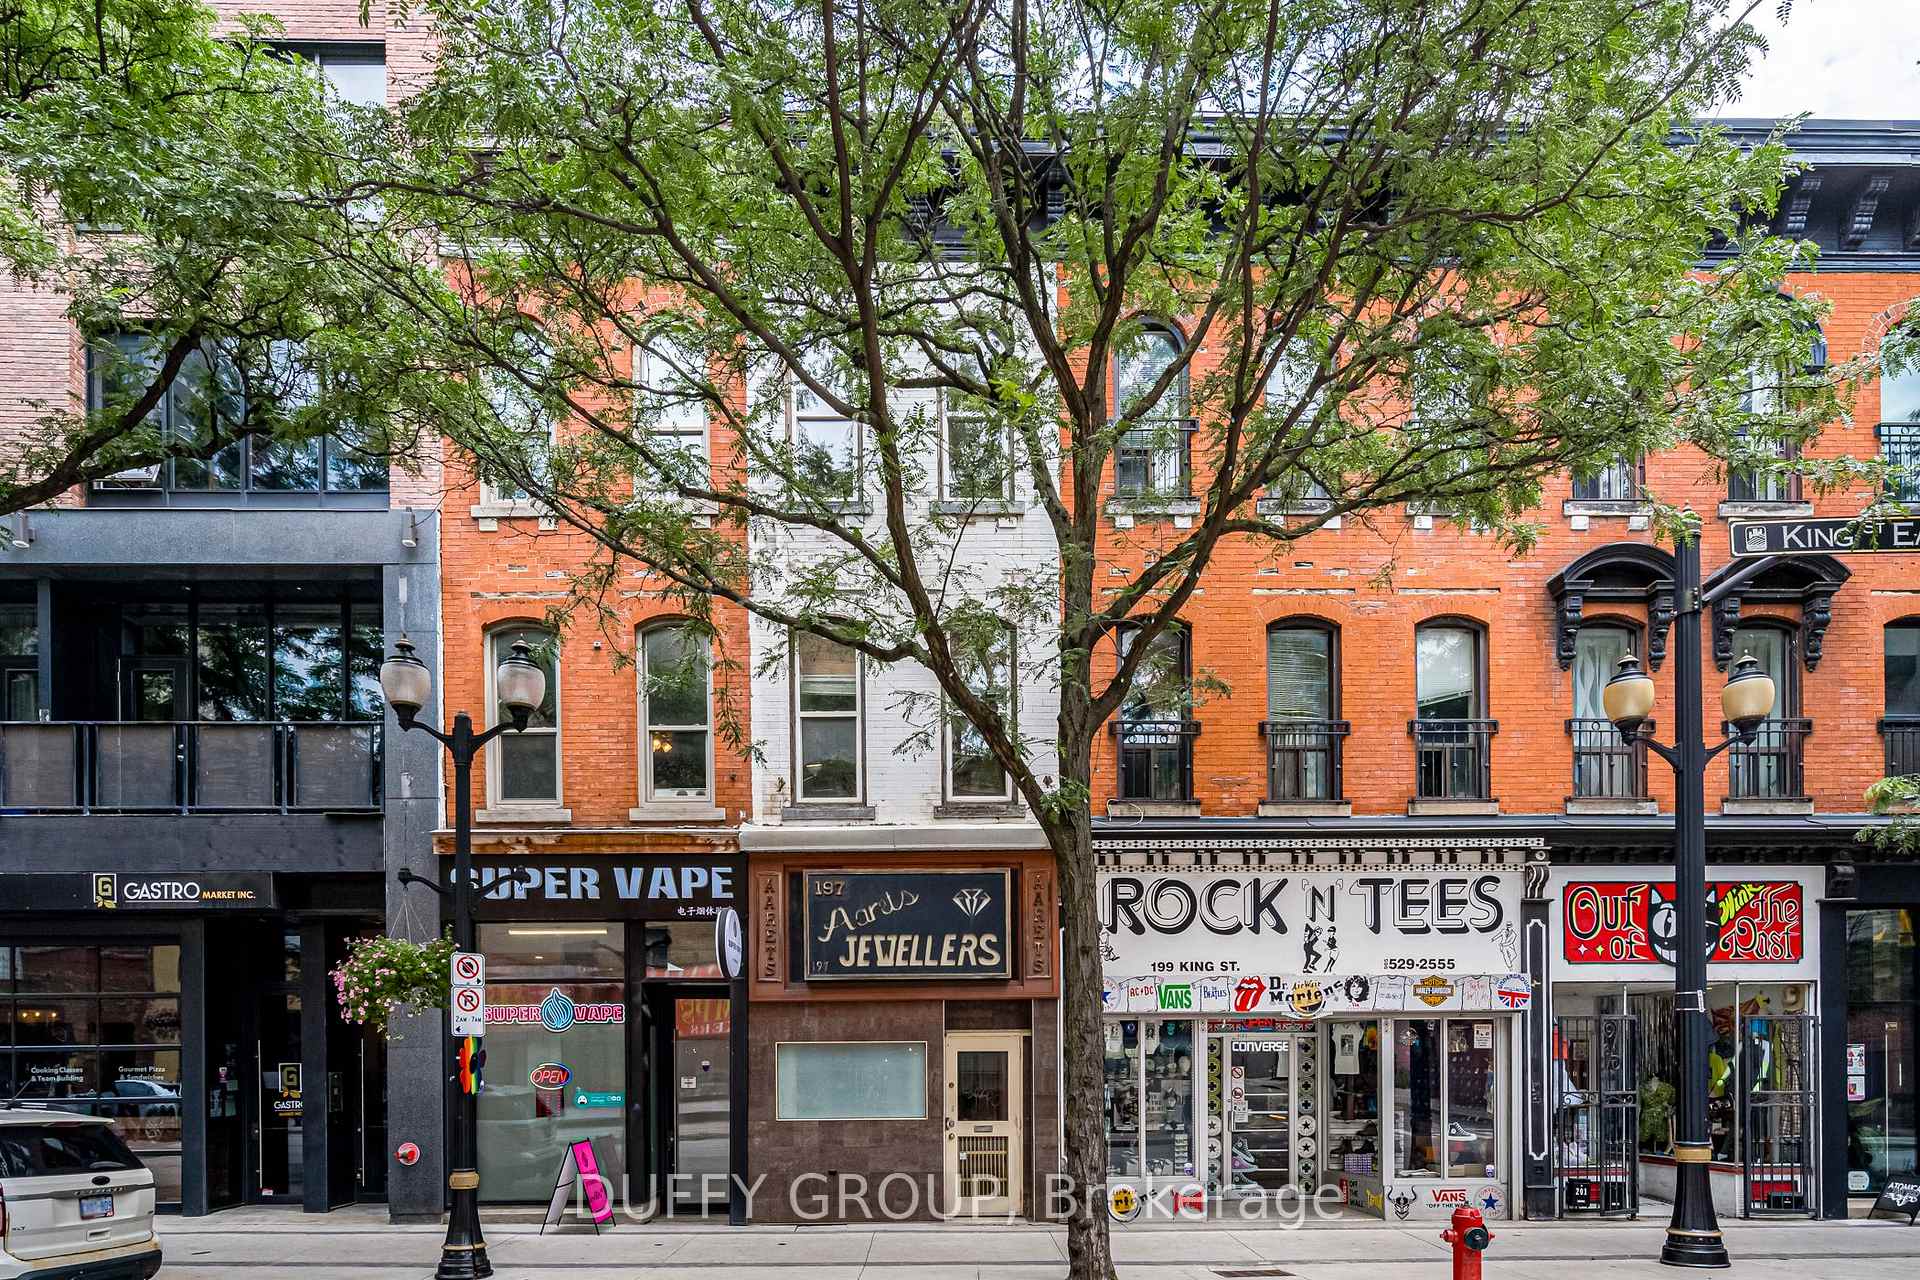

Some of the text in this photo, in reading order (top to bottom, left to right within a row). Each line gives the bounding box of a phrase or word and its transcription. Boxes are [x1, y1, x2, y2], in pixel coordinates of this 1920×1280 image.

[1782, 524, 1855, 549] KING
[1863, 521, 1886, 535] ST
[123, 881, 257, 900] GASTRO MARKET INC.
[612, 866, 735, 899] VAPE
[814, 880, 845, 896] 197
[1102, 877, 1290, 936] ROCK
[1349, 875, 1504, 935] TEES
[1567, 883, 1649, 941] Out
[1608, 929, 1649, 961] of
[1719, 915, 1800, 961] Past
[838, 934, 1001, 967] JEWELLERS
[1151, 961, 1241, 972] 199 KING ST.
[1388, 958, 1456, 970] 529-2555
[1269, 976, 1289, 990] Dr.
[1157, 984, 1193, 1010] VANS
[1268, 980, 1344, 1003] Martens
[484, 1005, 624, 1021] SUPER VAPE
[1232, 1041, 1289, 1052] CONVERSE
[30, 1065, 83, 1075] Cooking Classes
[118, 1065, 147, 1073] Gourmet
[532, 1070, 568, 1084] OPEN
[1431, 1188, 1467, 1203] VANS
[1575, 1187, 1588, 1196] 201
